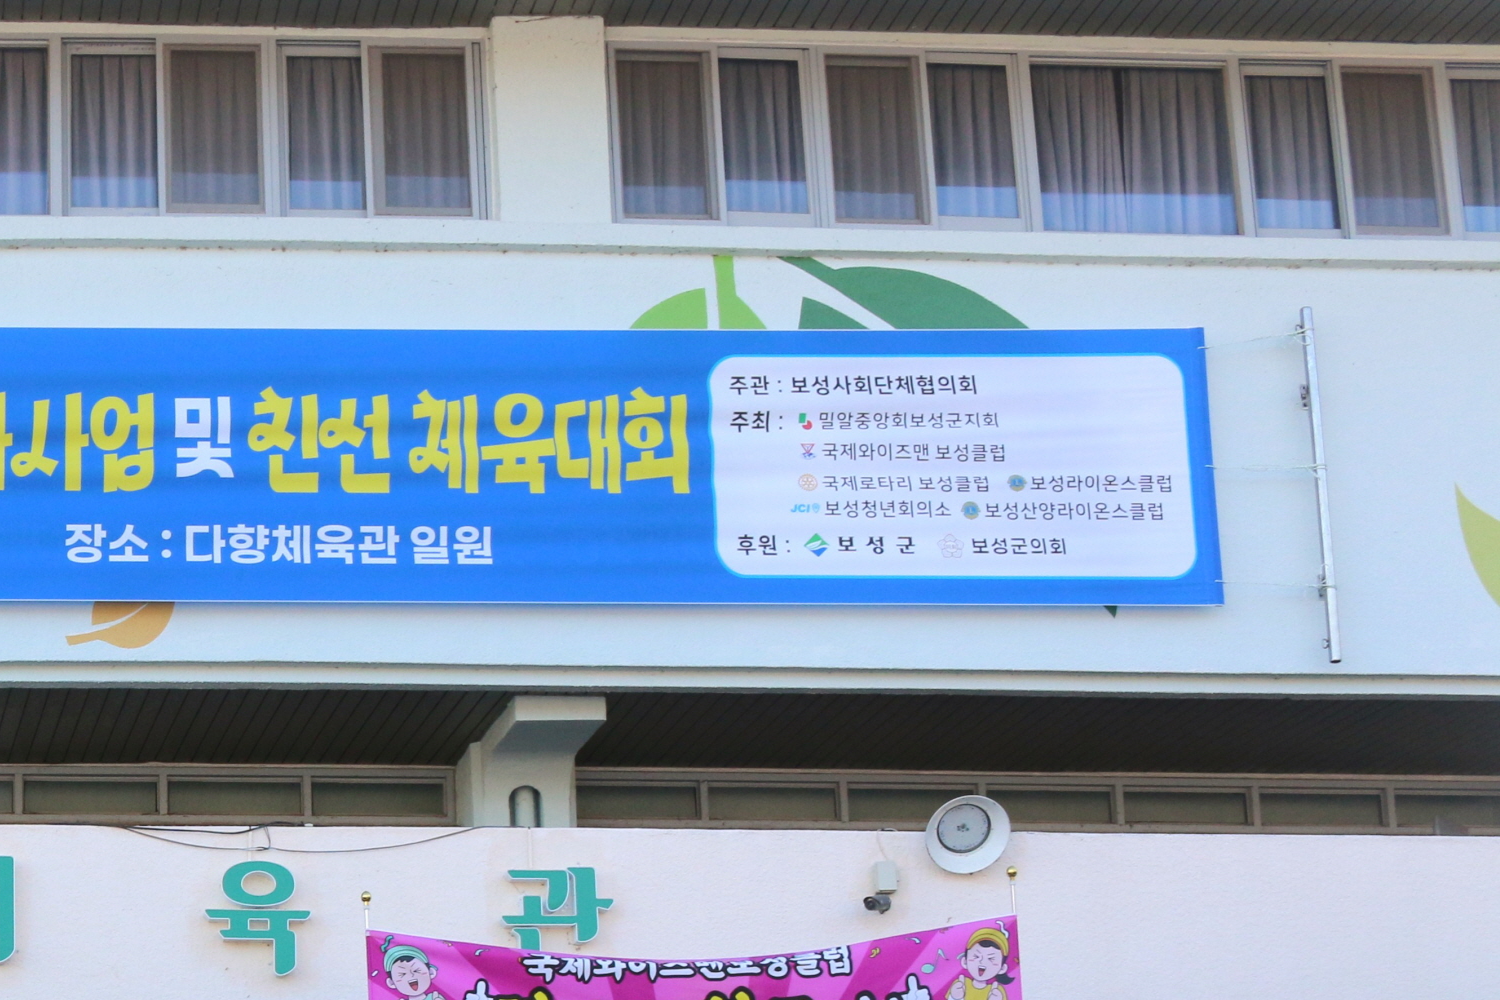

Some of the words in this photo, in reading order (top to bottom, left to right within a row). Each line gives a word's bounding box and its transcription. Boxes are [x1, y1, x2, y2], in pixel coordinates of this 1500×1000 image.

[791, 374, 978, 396] 보성사회단체협의회
[819, 411, 999, 430] 밀알중앙회보성군지회
[174, 396, 235, 478] 및
[935, 444, 1006, 463] 보성클럽
[822, 475, 912, 492] 국제로타리
[919, 476, 989, 493] 보성클럽
[1030, 475, 1172, 493] 보성라이온스클럽
[825, 500, 952, 518] 보성청년회의소
[985, 502, 1164, 521] 보성산양라이온스클럽
[185, 523, 400, 564] 다향체육관
[410, 525, 493, 565] 일원
[971, 537, 1067, 555] 보성군의회
